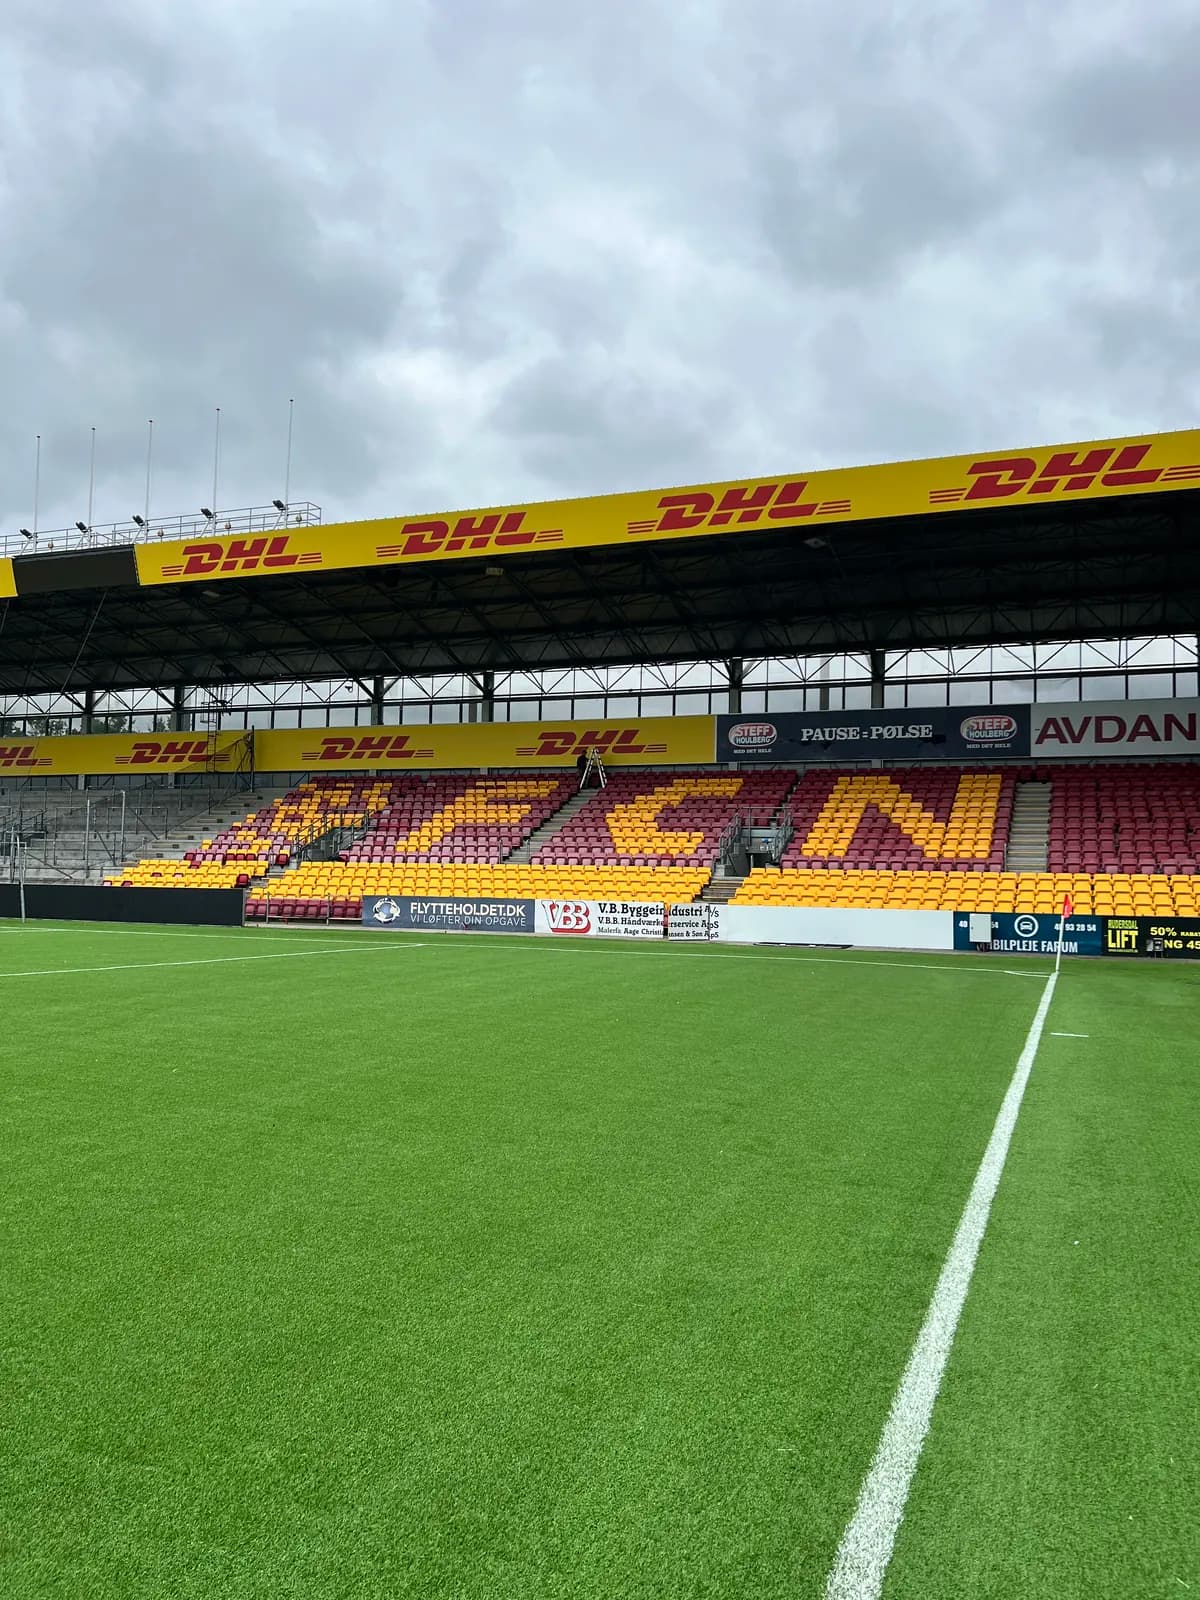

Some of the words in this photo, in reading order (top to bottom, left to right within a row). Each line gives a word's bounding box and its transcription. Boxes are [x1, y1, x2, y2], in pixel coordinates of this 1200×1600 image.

[964, 444, 1165, 500] DHL
[656, 482, 819, 531] DHL
[400, 512, 536, 555] DHL
[181, 536, 299, 575] DHL
[736, 726, 769, 736] STEFF
[801, 727, 860, 741] PAUSE
[870, 725, 933, 739] PØLSE
[969, 718, 1009, 730] STEFF
[1034, 713, 1197, 744] AVDAN
[536, 729, 646, 755] DHL
[736, 736, 771, 744] HOULBERG
[969, 729, 1009, 739] HOULBERG
[0, 746, 37, 767] HL
[129, 741, 214, 764] DHL
[319, 736, 416, 760] DHL
[410, 902, 525, 917] FLYTTEHOLDET.DK
[541, 900, 591, 933] VBB
[410, 915, 420, 923] VI
[423, 915, 460, 924] LØFTER
[464, 916, 482, 924] DIN
[485, 917, 526, 927] OPGAVE
[1108, 930, 1138, 948] LIFT
[1150, 927, 1177, 936] 50%
[1041, 940, 1078, 953] FARUM
[1164, 940, 1183, 949] NG
